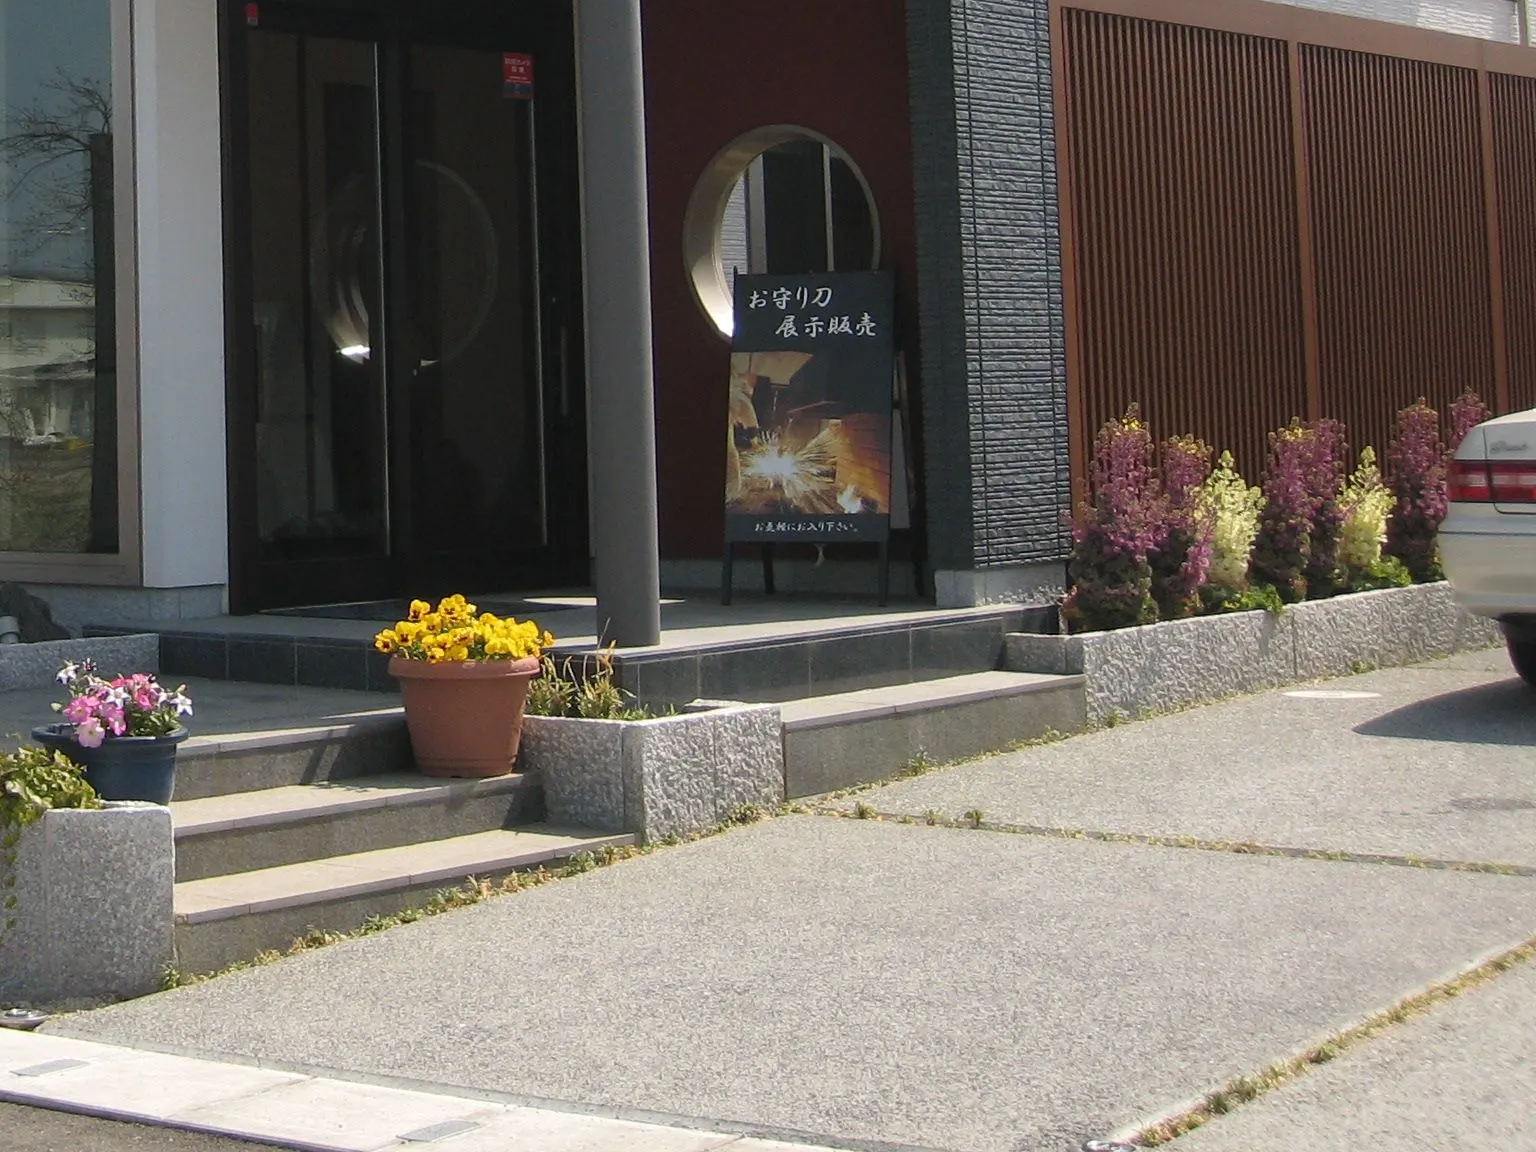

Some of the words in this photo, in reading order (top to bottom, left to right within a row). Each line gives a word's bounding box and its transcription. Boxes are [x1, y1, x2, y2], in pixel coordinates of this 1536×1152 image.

[748, 285, 833, 311] お守り刀
[775, 312, 878, 338] 展示販売
